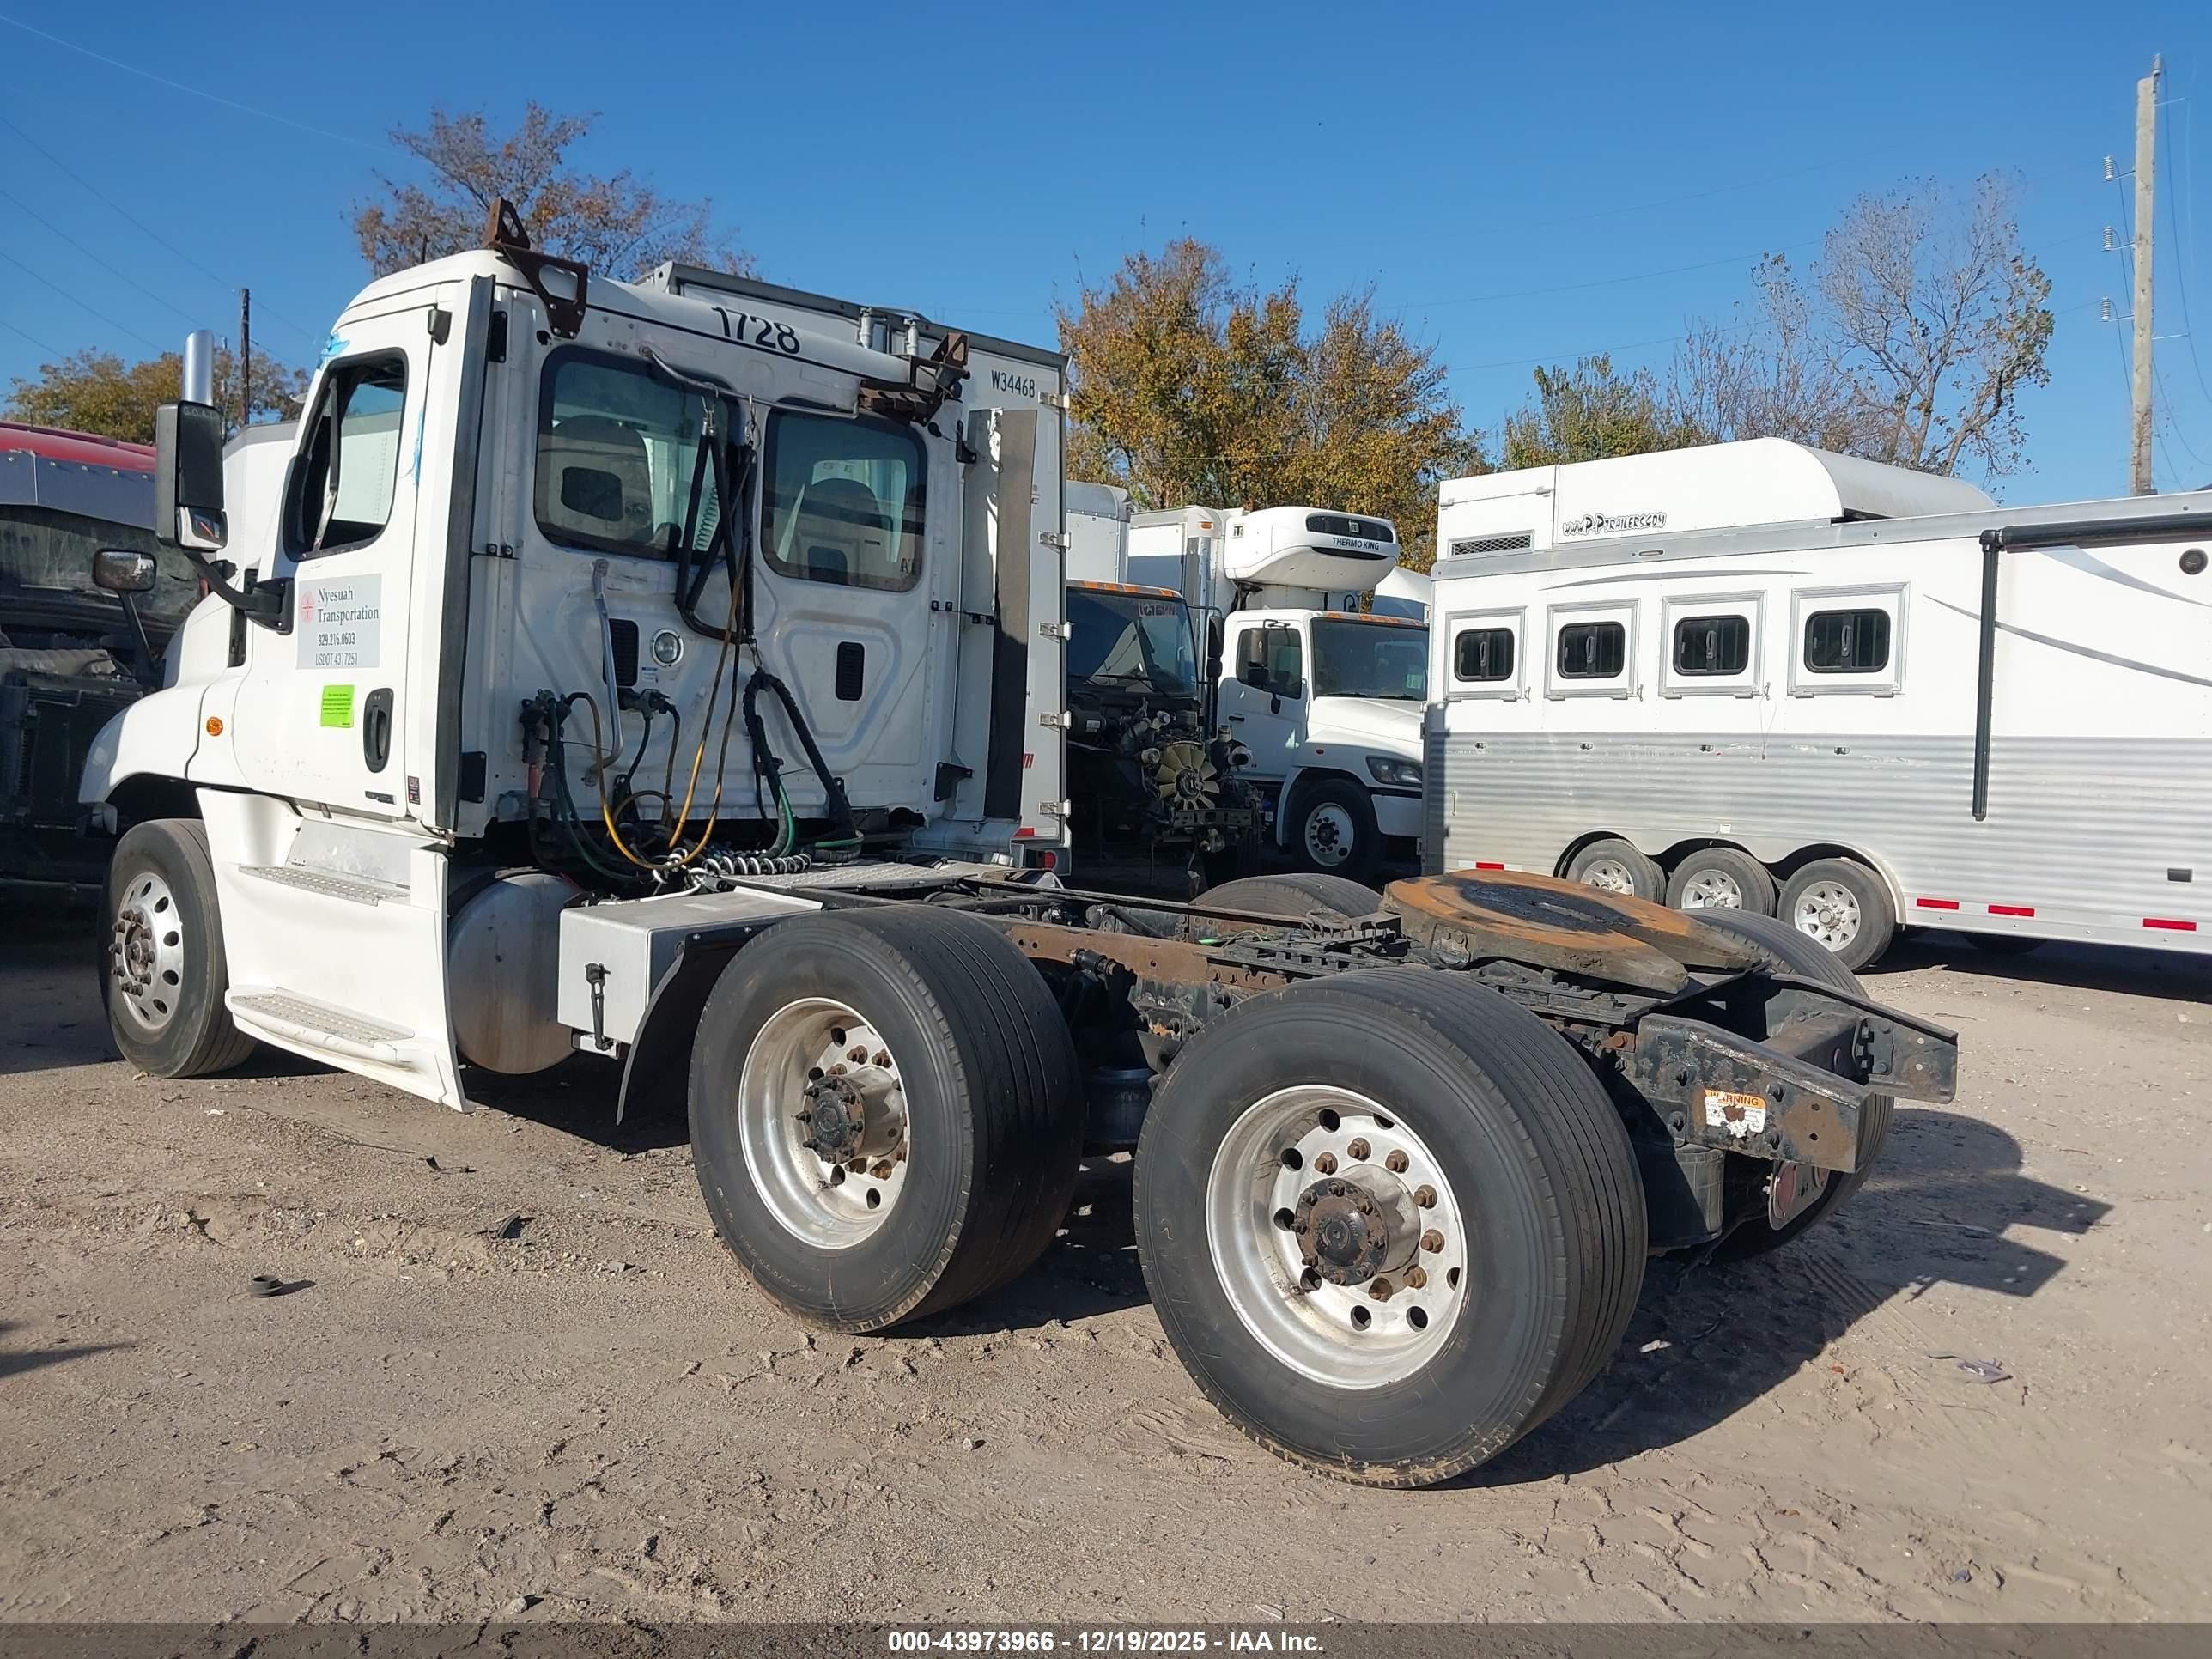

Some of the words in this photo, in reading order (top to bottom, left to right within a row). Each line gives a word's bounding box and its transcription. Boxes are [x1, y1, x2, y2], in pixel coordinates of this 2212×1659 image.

[711, 307, 800, 354] 1728
[991, 369, 1035, 398] W34468
[1333, 537, 1363, 548] THERMO
[1363, 540, 1380, 550] KING
[318, 586, 353, 606] Nyesuah
[318, 605, 379, 626] Transportation
[318, 632, 356, 646] 929.216.0603
[315, 653, 333, 665] USDOT
[334, 652, 357, 665] 4317251
